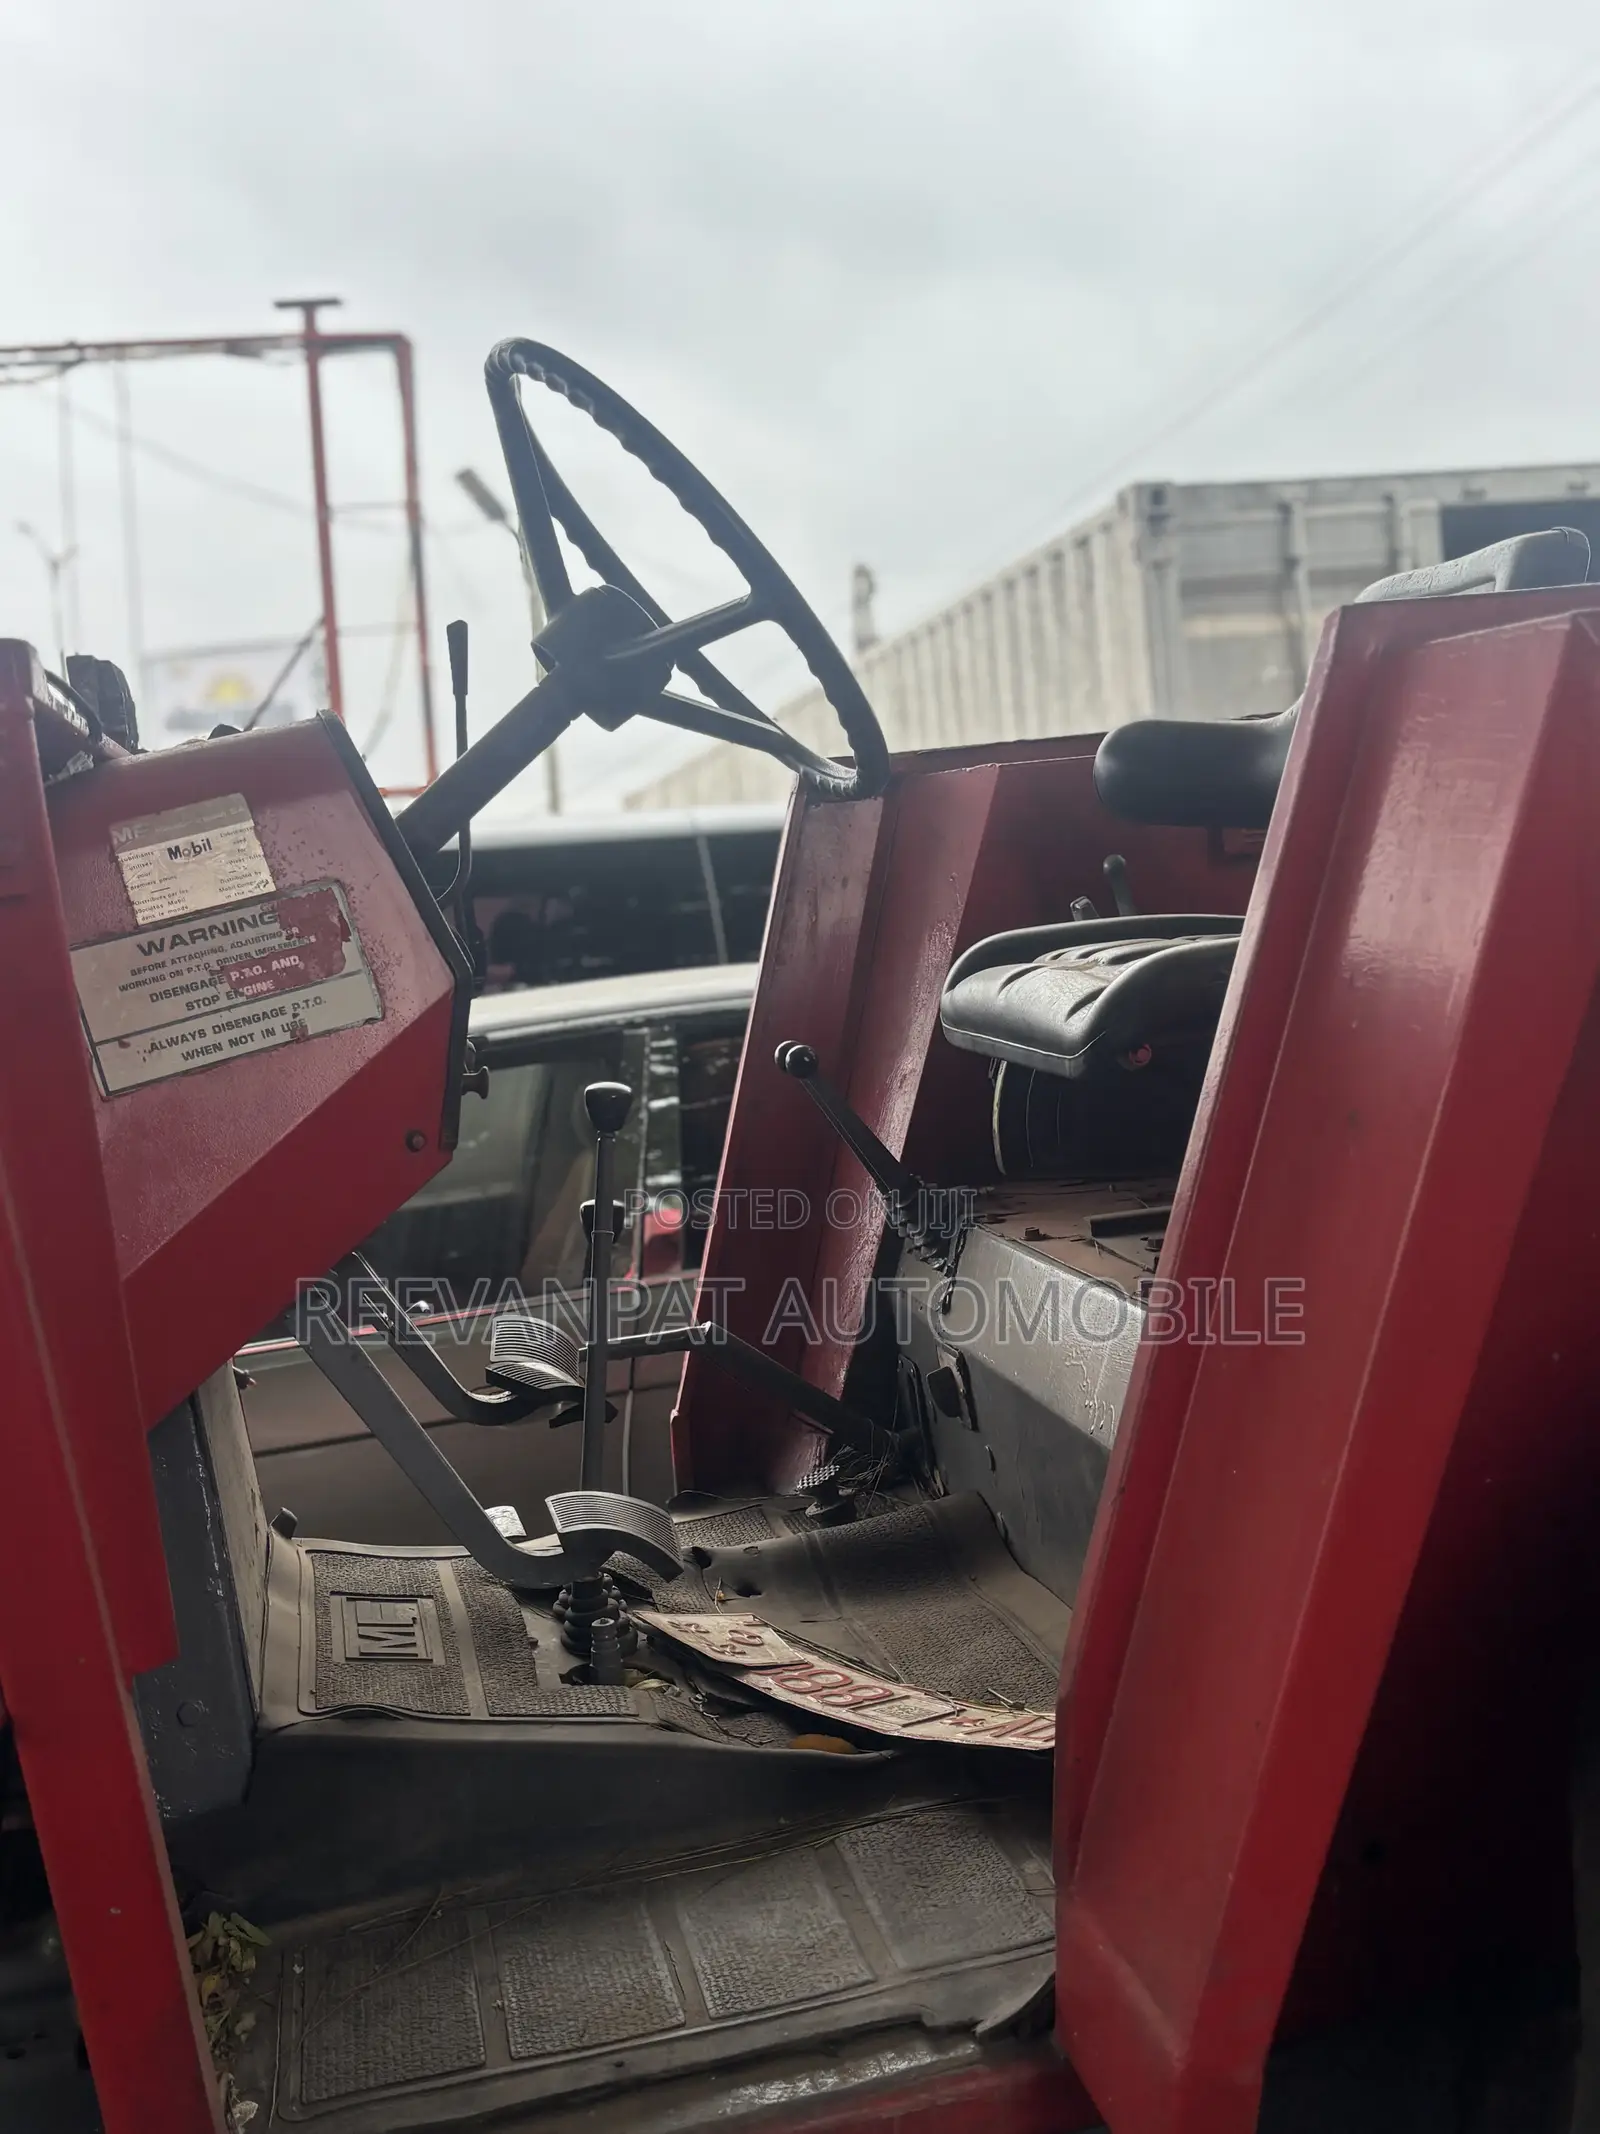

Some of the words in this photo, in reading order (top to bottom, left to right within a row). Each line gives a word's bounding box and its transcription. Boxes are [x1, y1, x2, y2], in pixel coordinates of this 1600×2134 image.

[166, 837, 212, 861] Mobil
[136, 910, 280, 957] WARNING
[118, 973, 167, 992] WORKING
[169, 968, 184, 980] ON
[216, 950, 252, 967] DRIVEN
[129, 960, 168, 977] BEFORE
[148, 974, 225, 1003] DISENGAGE
[185, 994, 221, 1012] STOP
[149, 1028, 208, 1052] ALWAYS
[211, 1006, 288, 1035] DISENGAGE
[291, 995, 327, 1013] P.T.O.
[181, 1043, 224, 1062] WHEN
[228, 1032, 256, 1049] NOT
[260, 1028, 277, 1041] IN
[281, 1018, 308, 1034] USE
